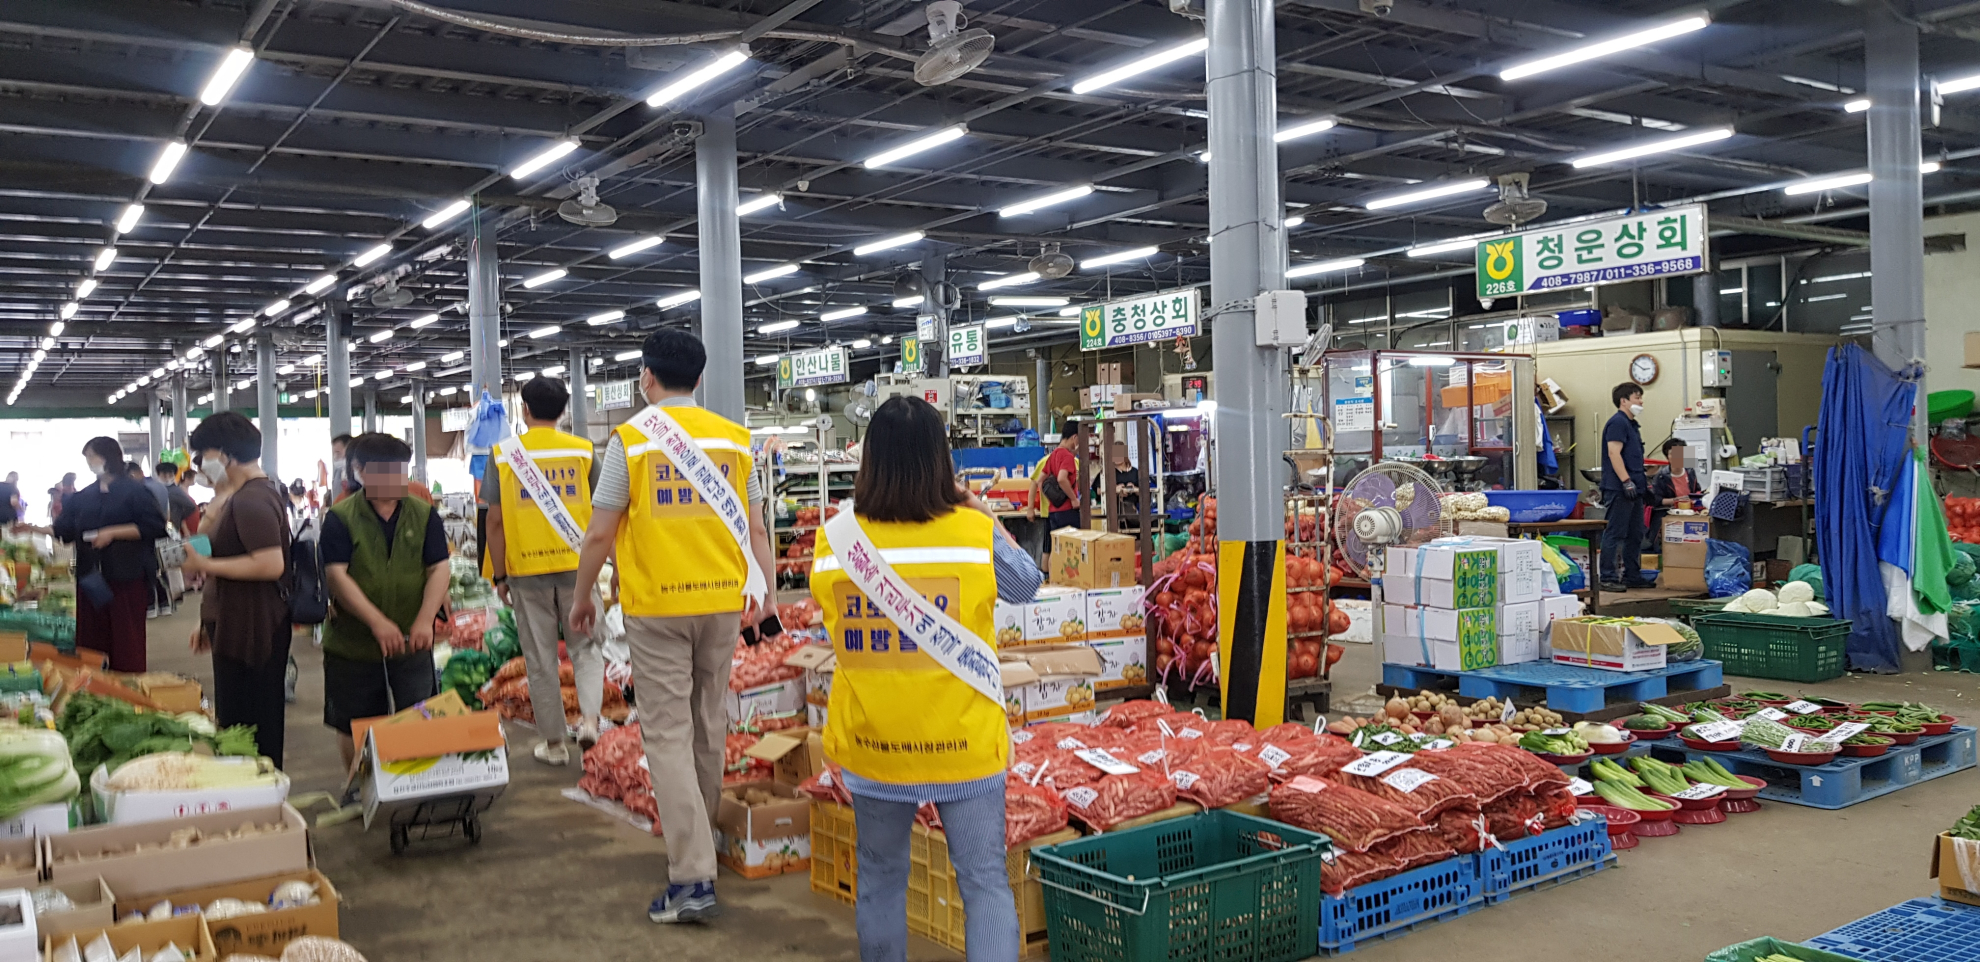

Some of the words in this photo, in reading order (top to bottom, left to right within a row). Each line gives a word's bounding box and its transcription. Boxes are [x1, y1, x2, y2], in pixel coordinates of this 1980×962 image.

[1536, 214, 1687, 270] 청운상회
[1486, 281, 1516, 295] 226호
[1112, 296, 1188, 333] 충청상회
[796, 352, 841, 376] 안산나물
[875, 573, 935, 635] 거리두기에
[1094, 608, 1119, 623] 감자
[1031, 615, 1057, 632] 감자
